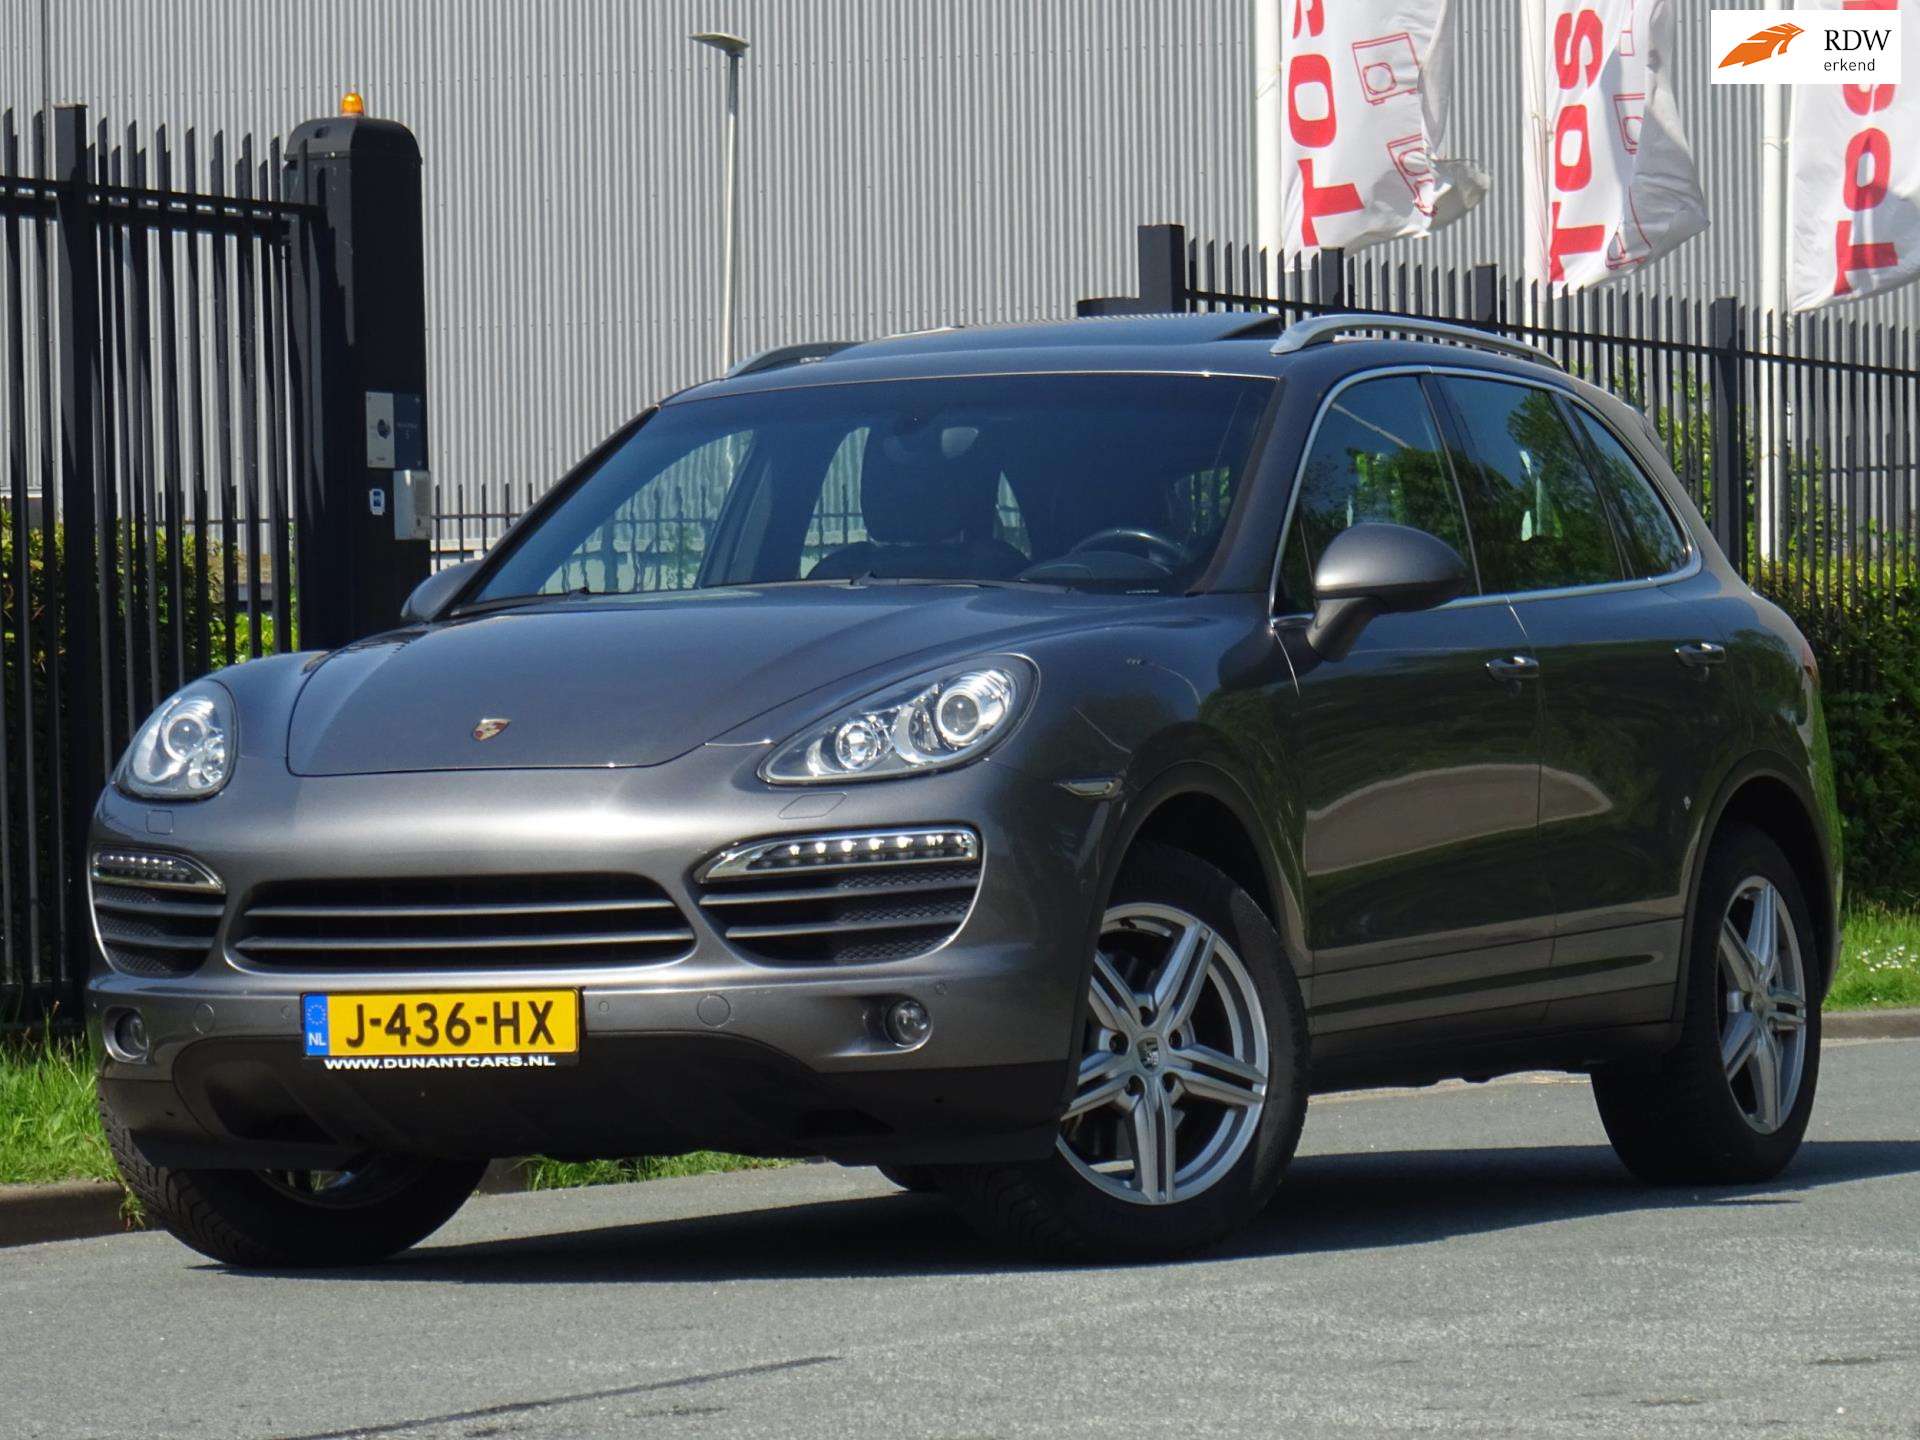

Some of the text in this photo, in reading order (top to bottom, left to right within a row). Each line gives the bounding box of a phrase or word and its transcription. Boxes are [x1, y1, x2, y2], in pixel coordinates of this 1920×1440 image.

[1549, 9, 1605, 281] TOS
[345, 1000, 555, 1048] J-436-HX
[308, 1033, 326, 1047] NL
[324, 1056, 556, 1070] WWW.DUNANTCARS.NL
